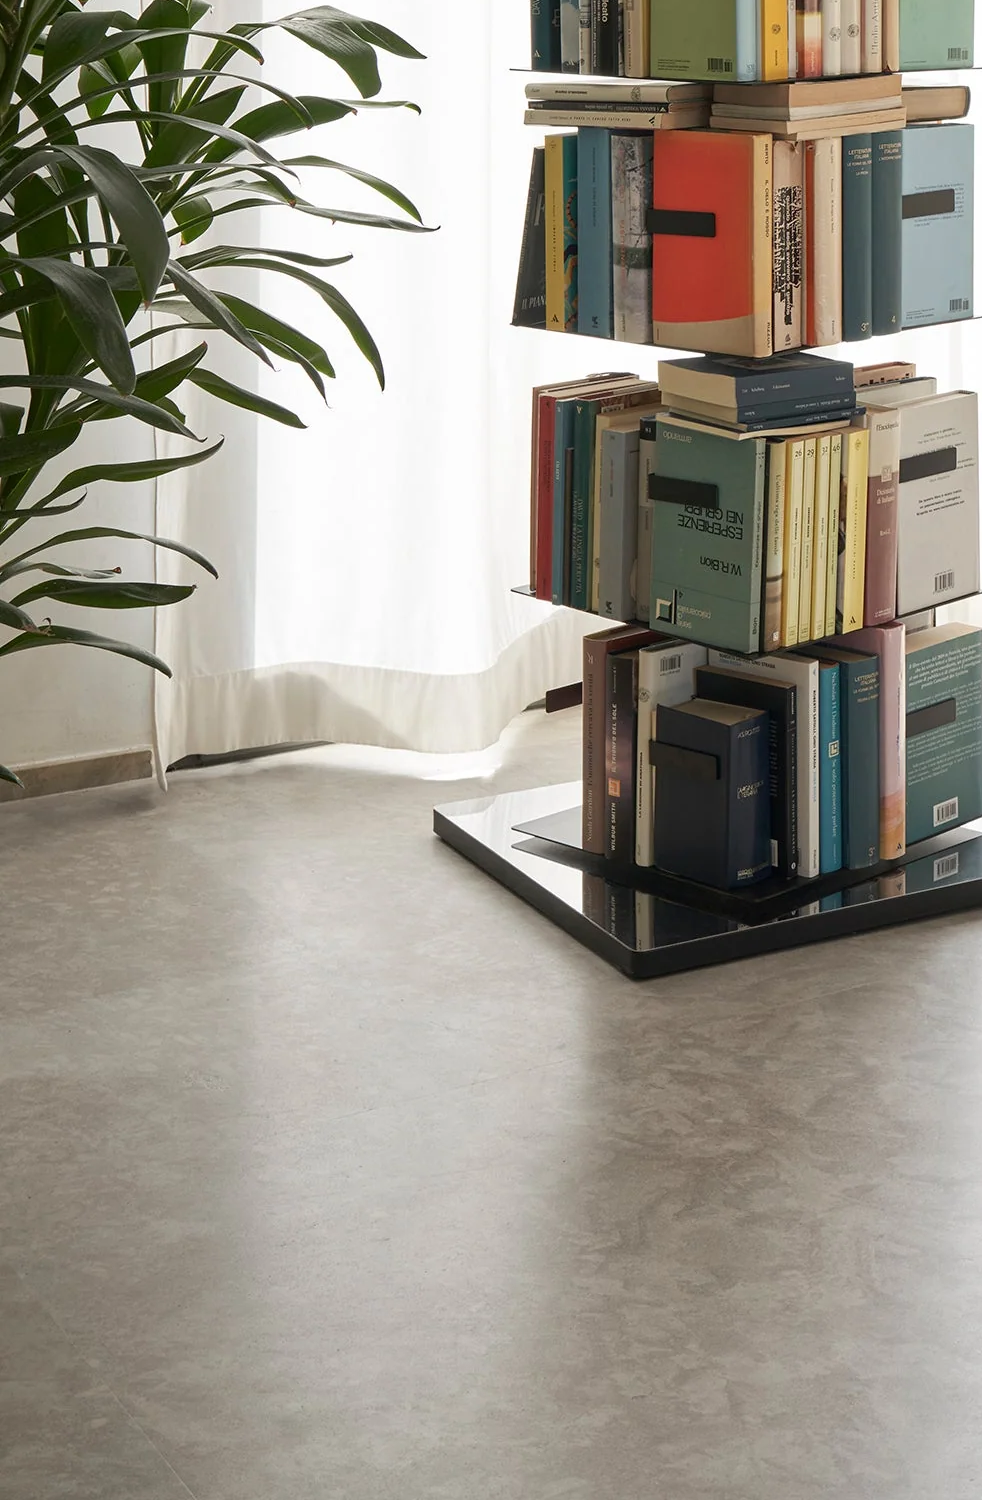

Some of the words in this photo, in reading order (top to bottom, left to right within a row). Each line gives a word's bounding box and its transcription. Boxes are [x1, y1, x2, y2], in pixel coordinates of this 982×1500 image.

[528, 293, 547, 309] PIAN
[891, 315, 896, 324] 4
[663, 431, 693, 444] armando
[795, 449, 803, 458] 26
[806, 448, 814, 457] 29
[832, 442, 841, 452] 46
[577, 498, 585, 521] DAVID
[684, 503, 723, 521] GRUPPI
[726, 510, 744, 525] NEI
[677, 514, 743, 541] ESPERIENZE
[830, 672, 838, 701] Nicholas
[586, 789, 594, 821] Gordon
[586, 820, 594, 843] Noah
